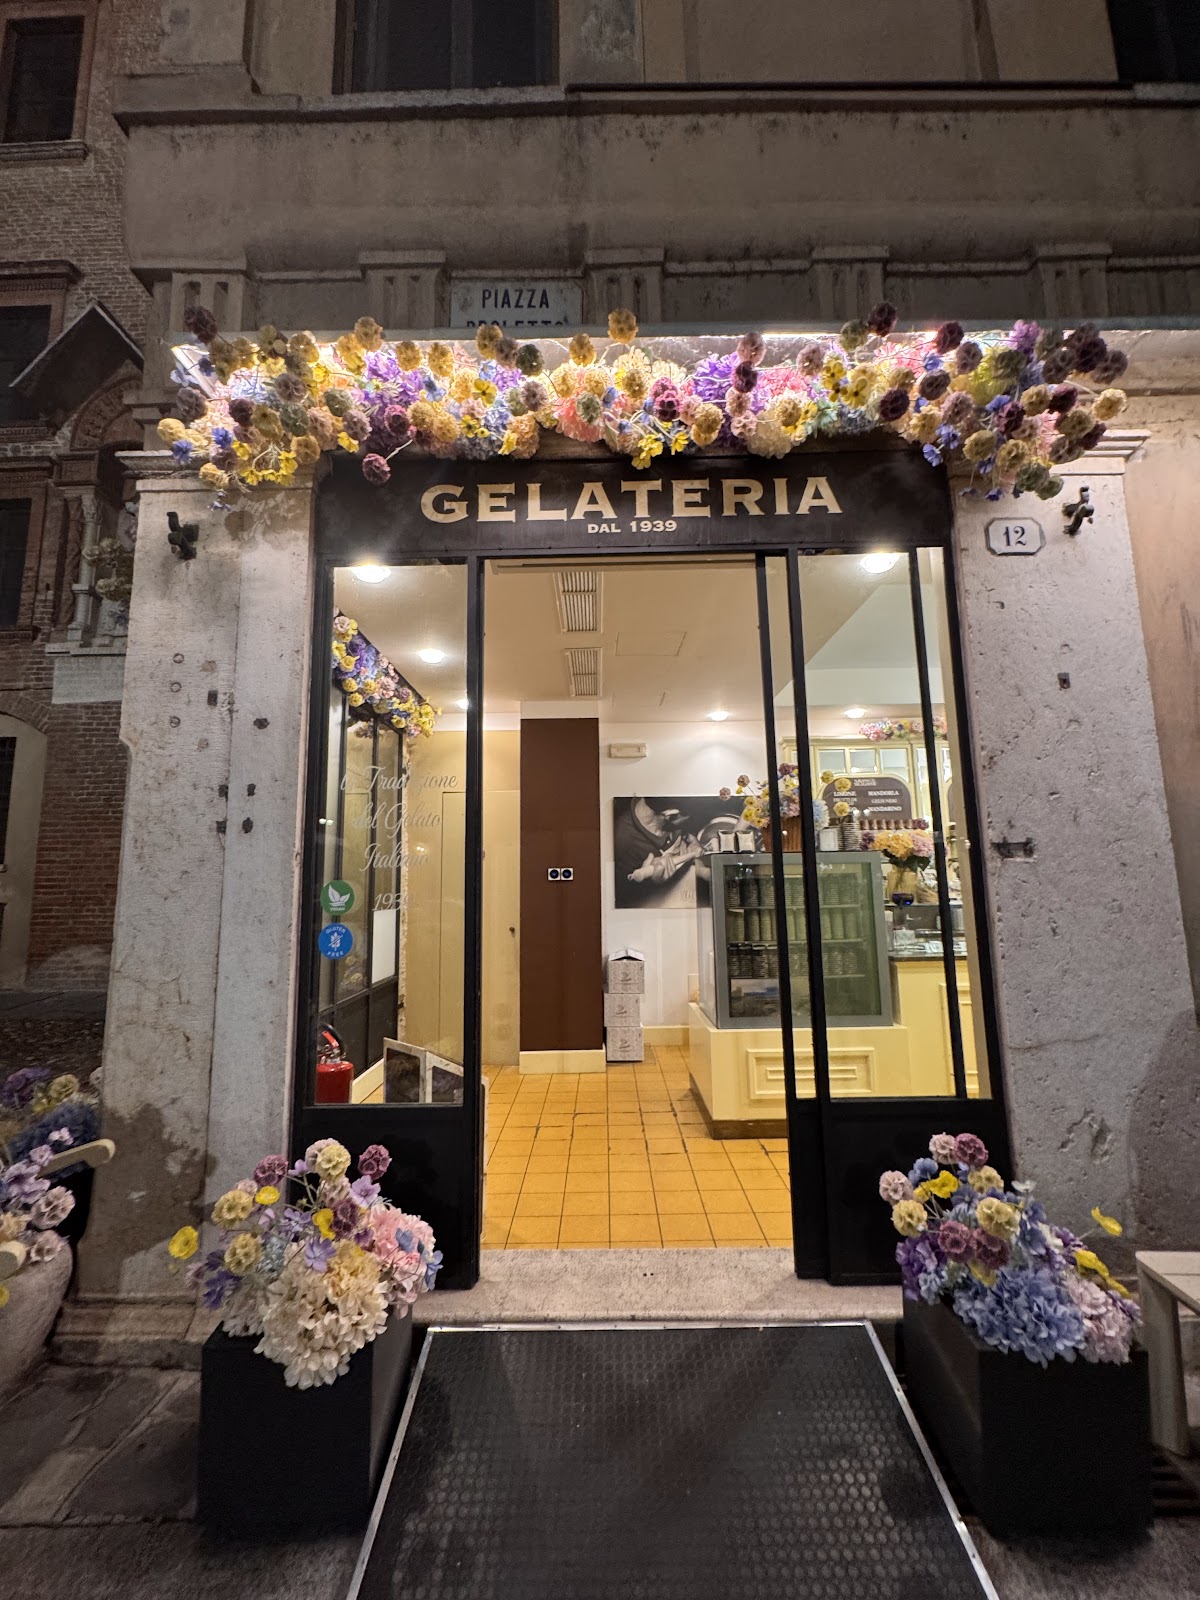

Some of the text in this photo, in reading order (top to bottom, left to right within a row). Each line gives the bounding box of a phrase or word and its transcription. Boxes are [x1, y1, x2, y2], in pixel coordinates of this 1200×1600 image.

[482, 288, 550, 309] PIAZZA
[420, 476, 843, 524] GELATERIA
[587, 520, 678, 534] DAL 1939
[1003, 525, 1026, 547] 12
[362, 766, 458, 796] Tradione
[325, 926, 346, 934] GLUTEN
